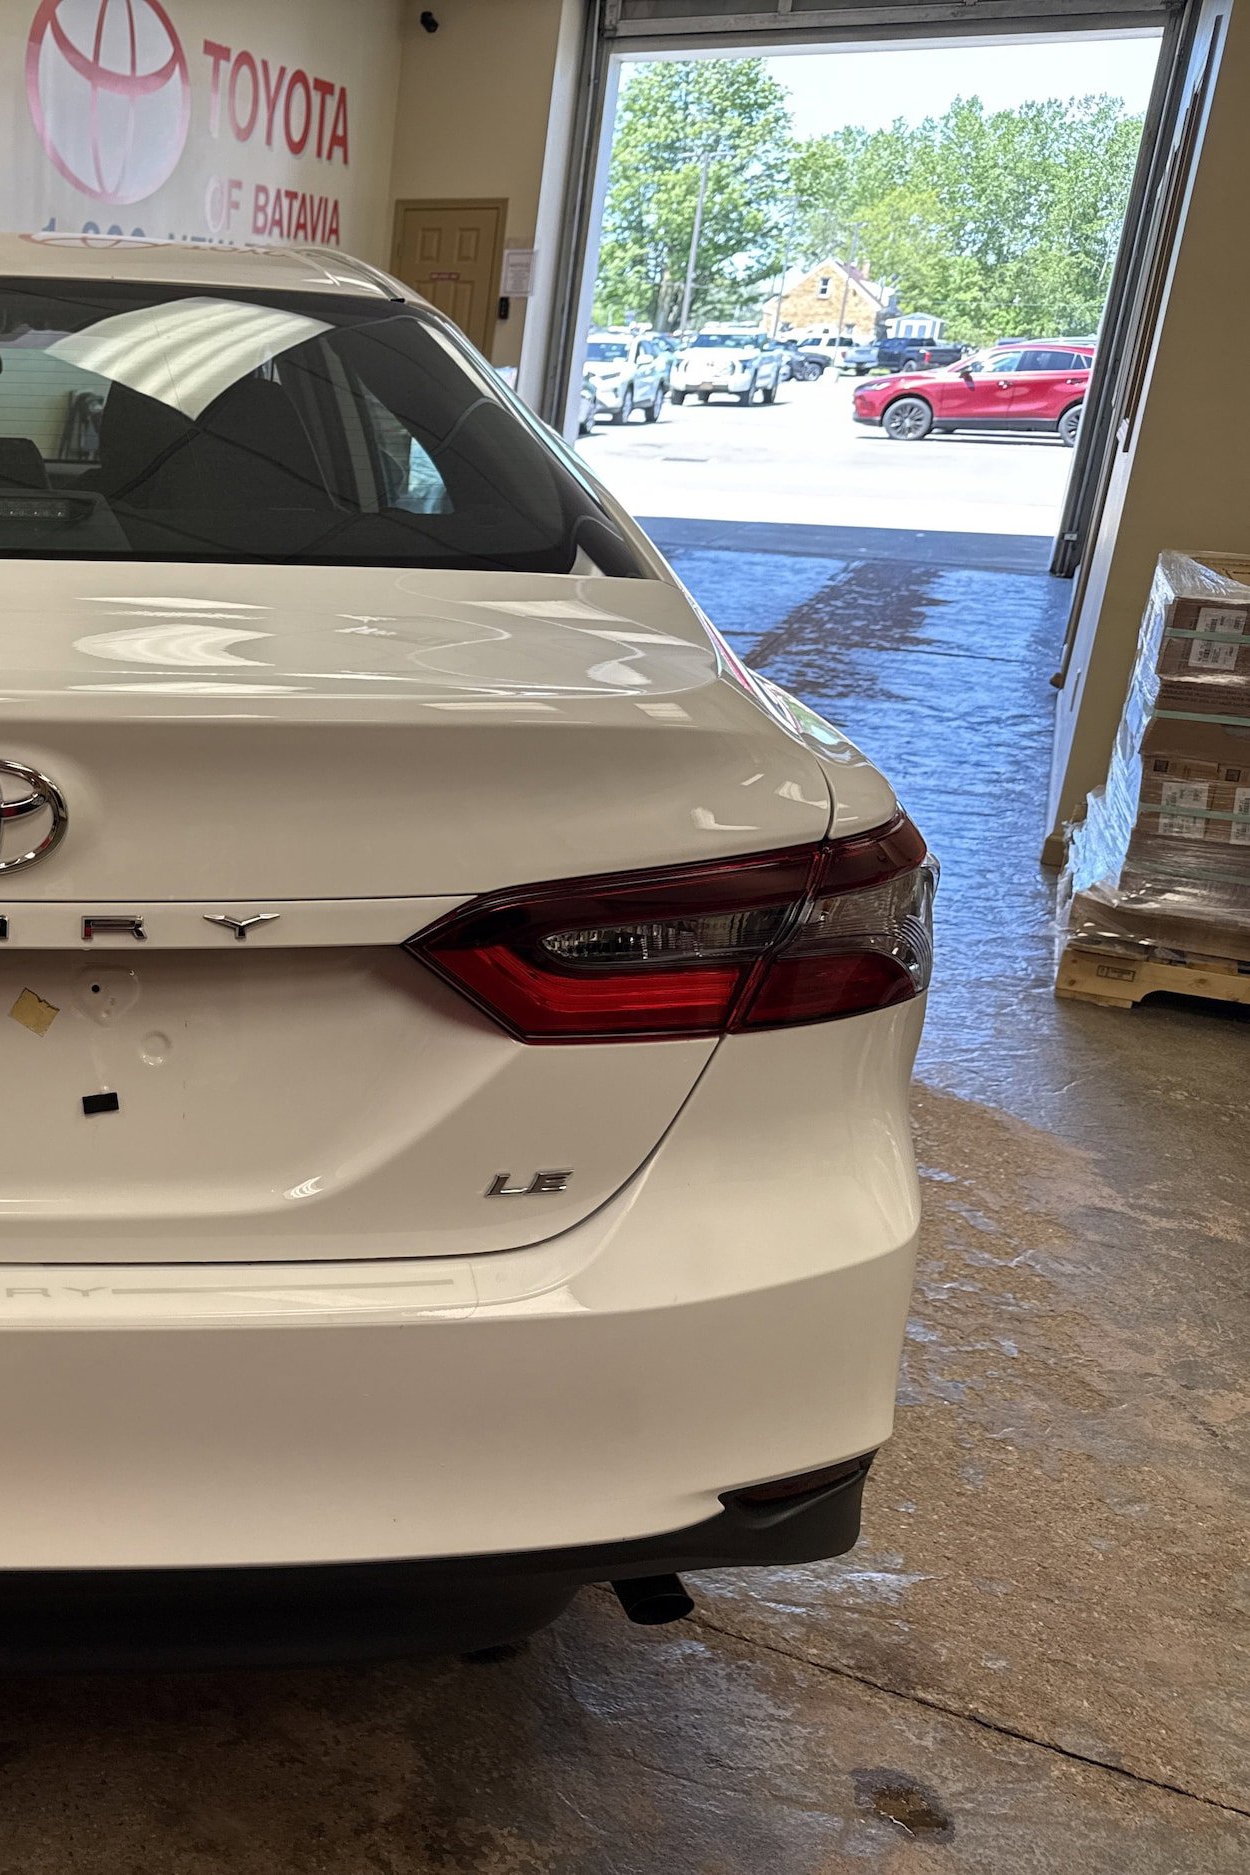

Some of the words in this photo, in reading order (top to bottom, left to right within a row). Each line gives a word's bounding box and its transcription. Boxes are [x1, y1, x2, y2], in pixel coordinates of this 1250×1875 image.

[203, 39, 349, 166] TOYOTA
[205, 174, 243, 234] OF
[251, 184, 340, 246] BATAVIA
[484, 1168, 574, 1198] LE
